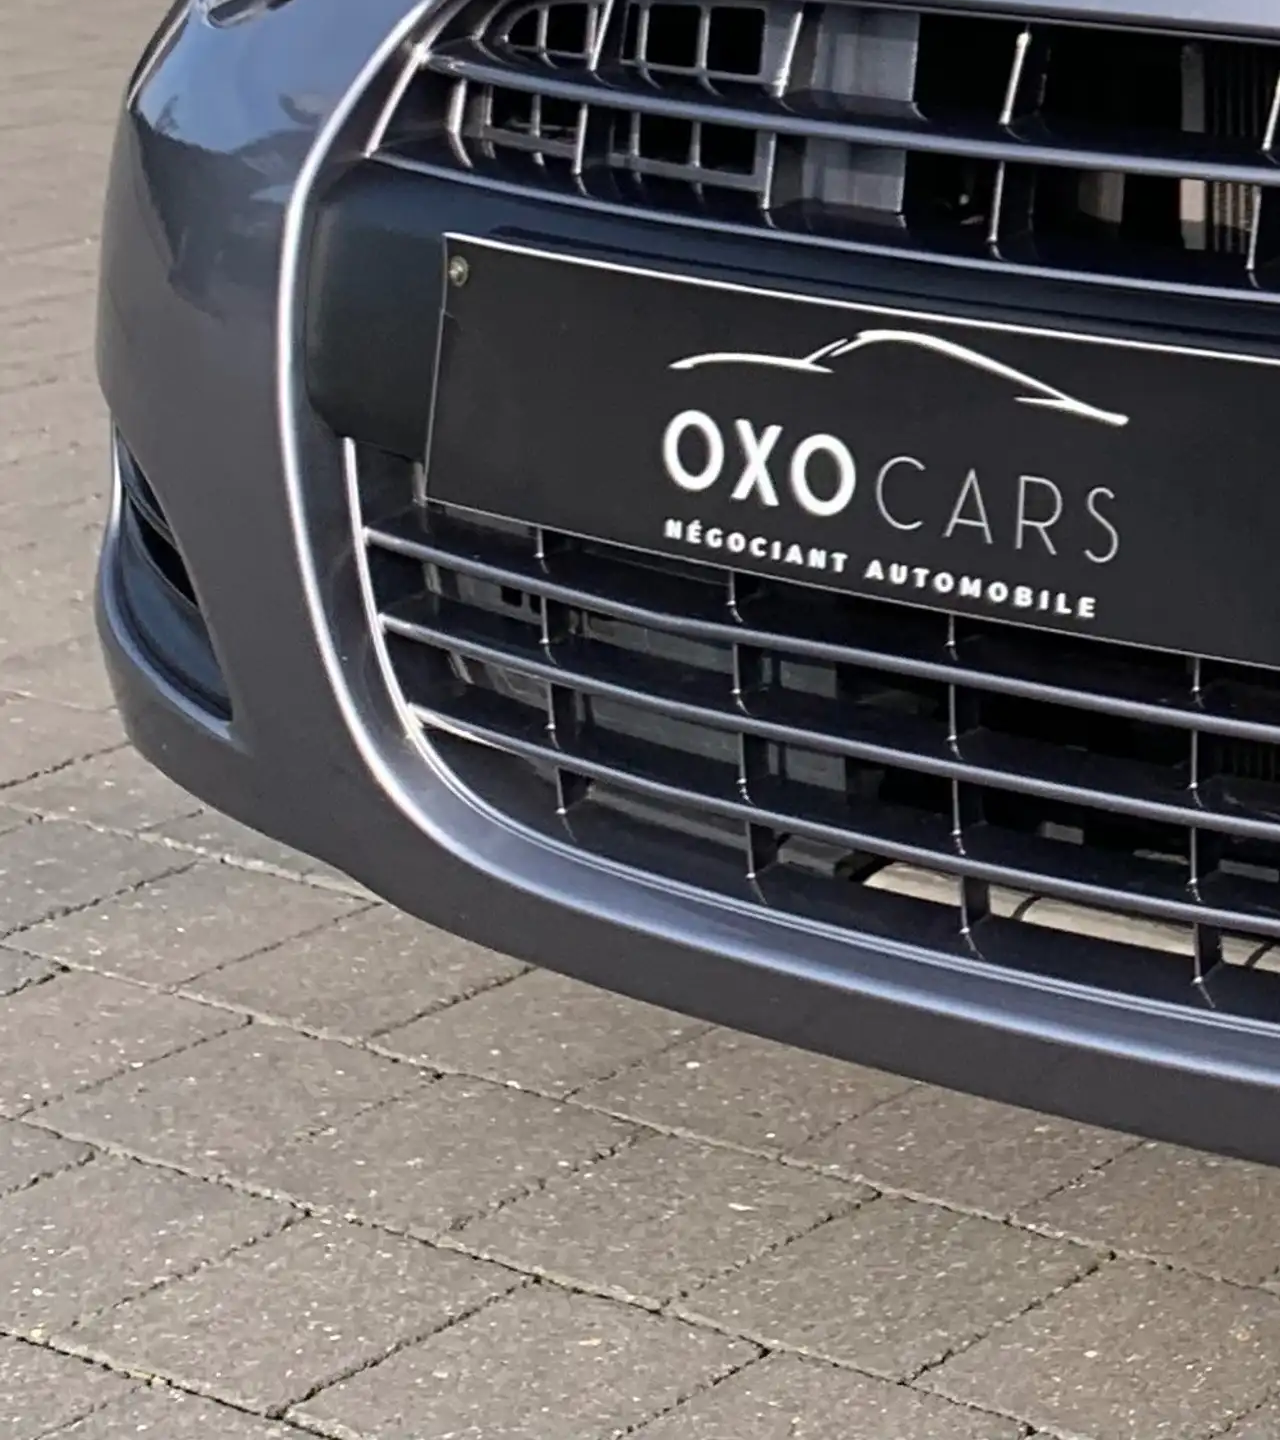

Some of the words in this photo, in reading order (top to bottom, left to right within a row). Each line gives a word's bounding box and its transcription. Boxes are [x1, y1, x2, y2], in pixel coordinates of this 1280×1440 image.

[662, 409, 857, 517] OXO
[876, 455, 1120, 564] CARS
[663, 517, 848, 573] NÉGOCIANT
[864, 558, 1097, 620] AUTOMOBILE
